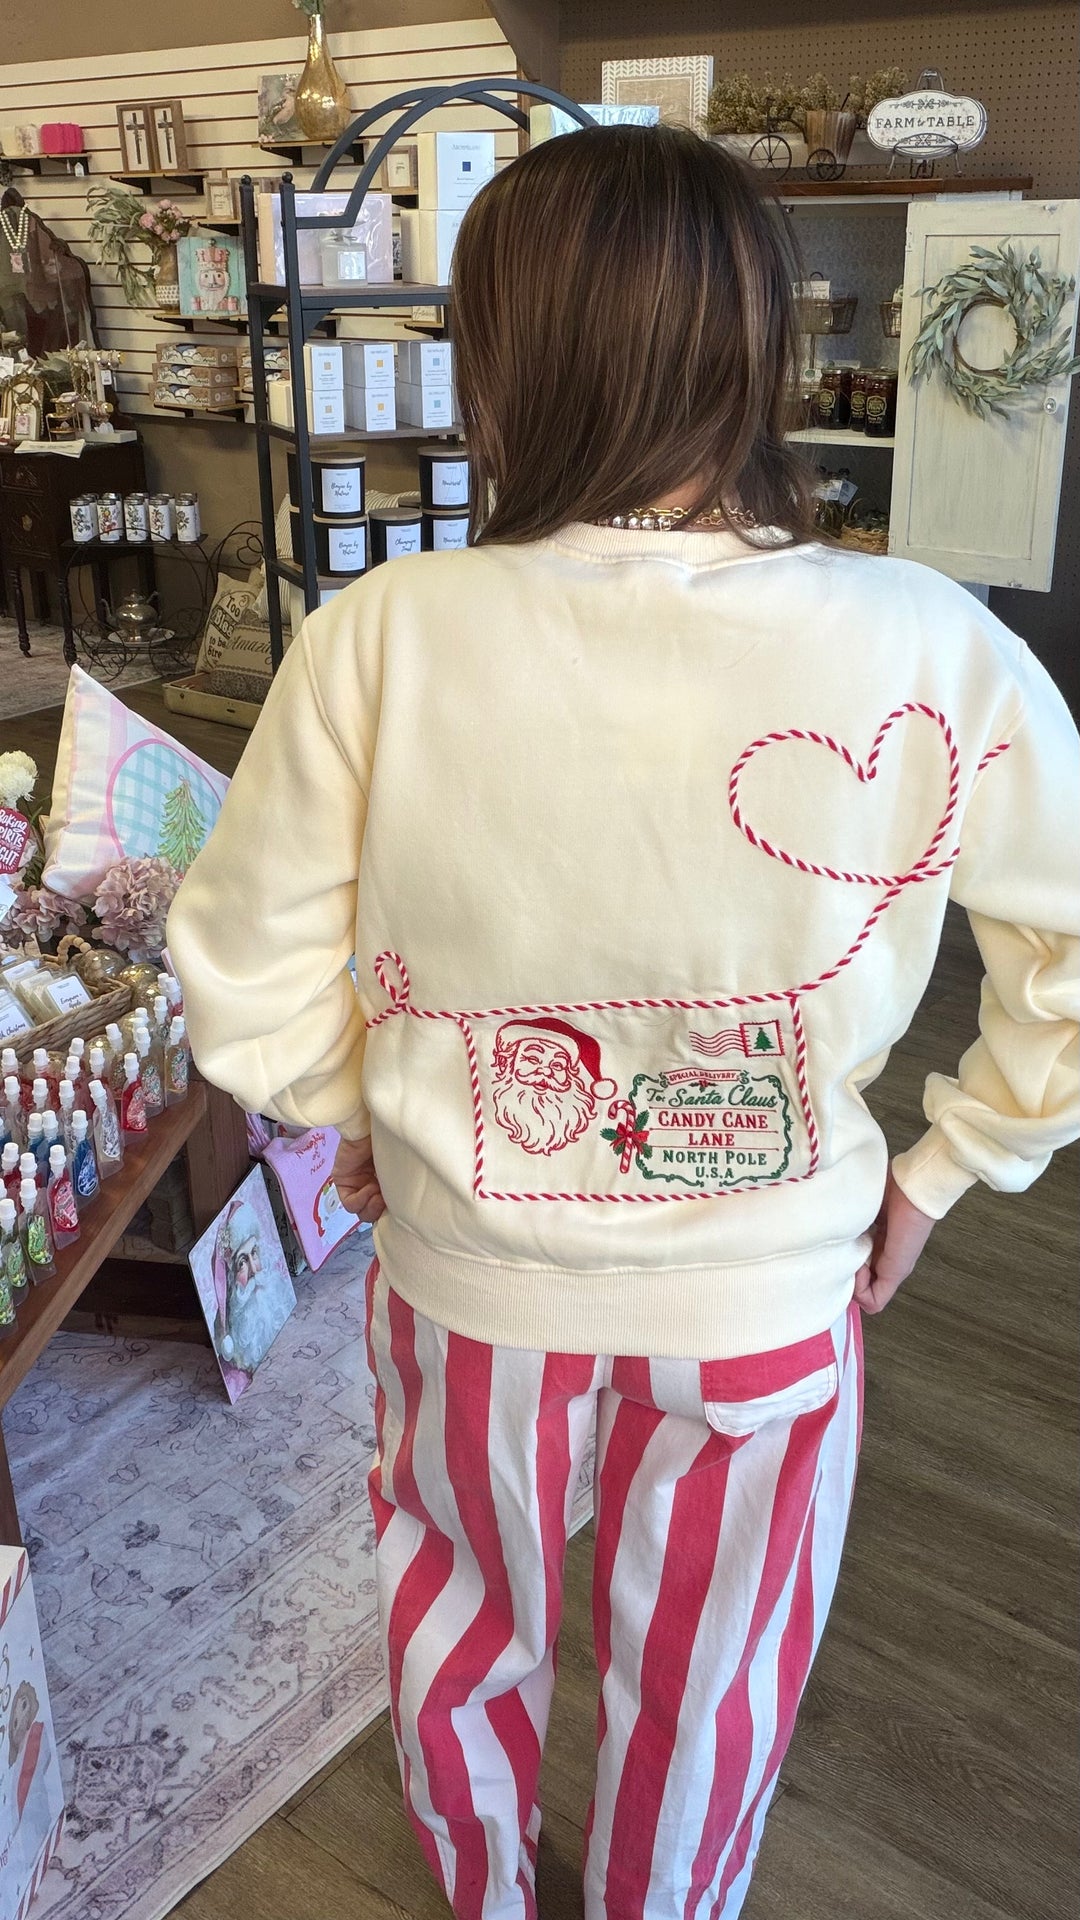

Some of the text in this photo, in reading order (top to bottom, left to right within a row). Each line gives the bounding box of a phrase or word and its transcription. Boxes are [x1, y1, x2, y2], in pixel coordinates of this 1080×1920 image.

[875, 116, 914, 129] FARM
[926, 115, 975, 128] TABLE
[226, 595, 241, 617] Too
[213, 607, 236, 637] Bles
[0, 825, 24, 848] PIRITS
[668, 1069, 736, 1082] SPECIAL DELIVERY
[668, 1088, 725, 1107] Santa
[727, 1084, 778, 1108] Claus
[658, 1110, 768, 1129] CANDY CANE
[295, 1132, 326, 1159] Naughty
[688, 1132, 735, 1147] LANE
[312, 1150, 321, 1161] or
[662, 1149, 767, 1165] NORTH POLE
[311, 1158, 325, 1175] Nice
[695, 1166, 734, 1179] U.S.A
